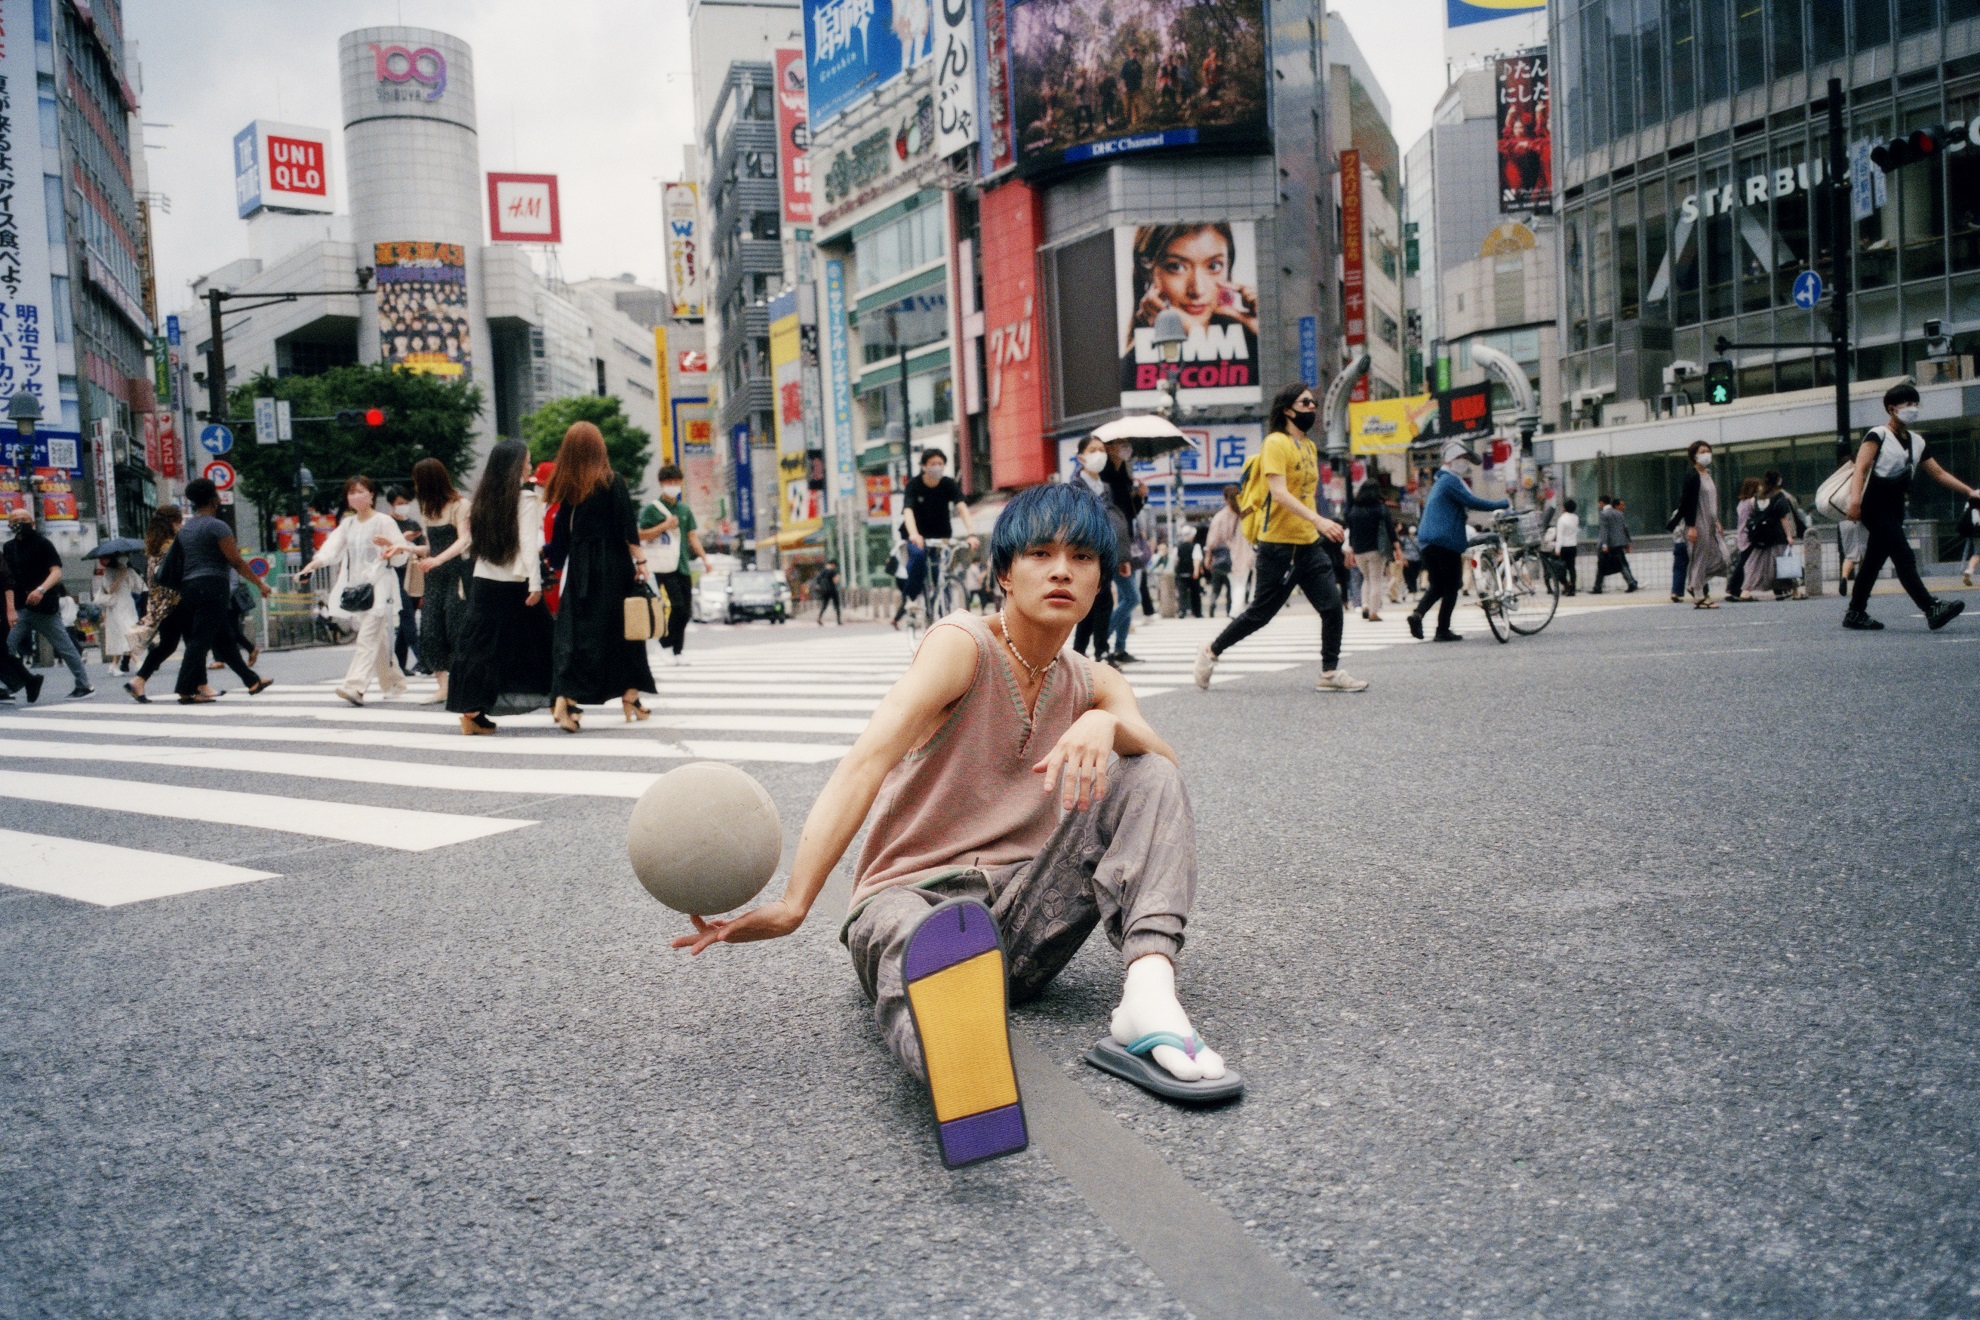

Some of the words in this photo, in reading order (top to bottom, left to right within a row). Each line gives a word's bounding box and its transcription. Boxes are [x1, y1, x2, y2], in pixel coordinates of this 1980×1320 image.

[367, 42, 447, 99] 109
[273, 142, 315, 167] UNI
[1092, 140, 1117, 156] DHC
[1118, 132, 1164, 151] Channel
[275, 165, 320, 189] QLO
[1681, 148, 1851, 224] STARBU
